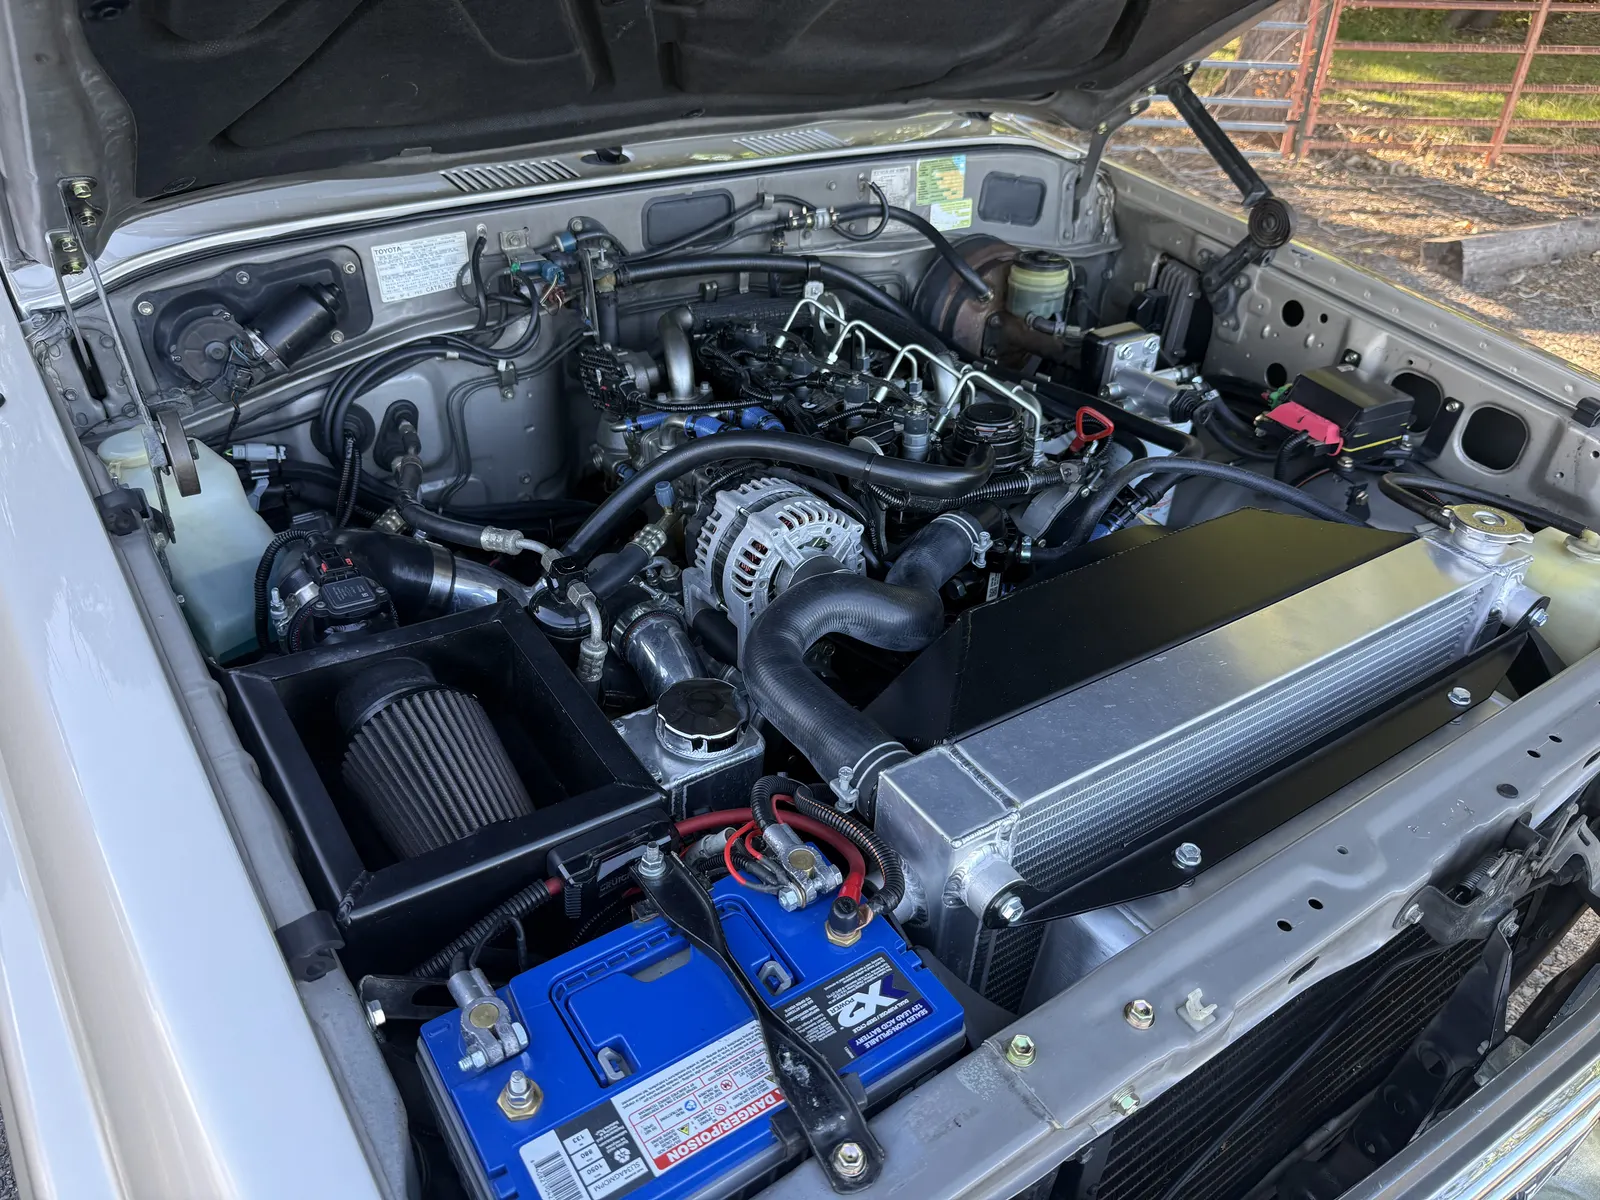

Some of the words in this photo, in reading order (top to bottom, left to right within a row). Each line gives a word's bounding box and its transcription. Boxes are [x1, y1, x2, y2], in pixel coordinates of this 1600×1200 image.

[374, 246, 401, 255] TOYOTA
[425, 281, 456, 292] CATALYST
[830, 998, 855, 1015] POWER
[910, 1002, 923, 1012] 12V
[894, 1008, 912, 1022] LEAD
[905, 1007, 928, 1024] SEALED
[851, 1022, 866, 1033] CYCLE
[879, 1017, 896, 1030] ACID
[853, 1026, 882, 1045] BATTERY
[862, 1020, 907, 1048] NON-SPILLABLE
[666, 1092, 776, 1163] DANGER/POISON
[571, 1133, 584, 1143] 133
[579, 1148, 593, 1159] 880
[585, 1162, 602, 1175] 1050
